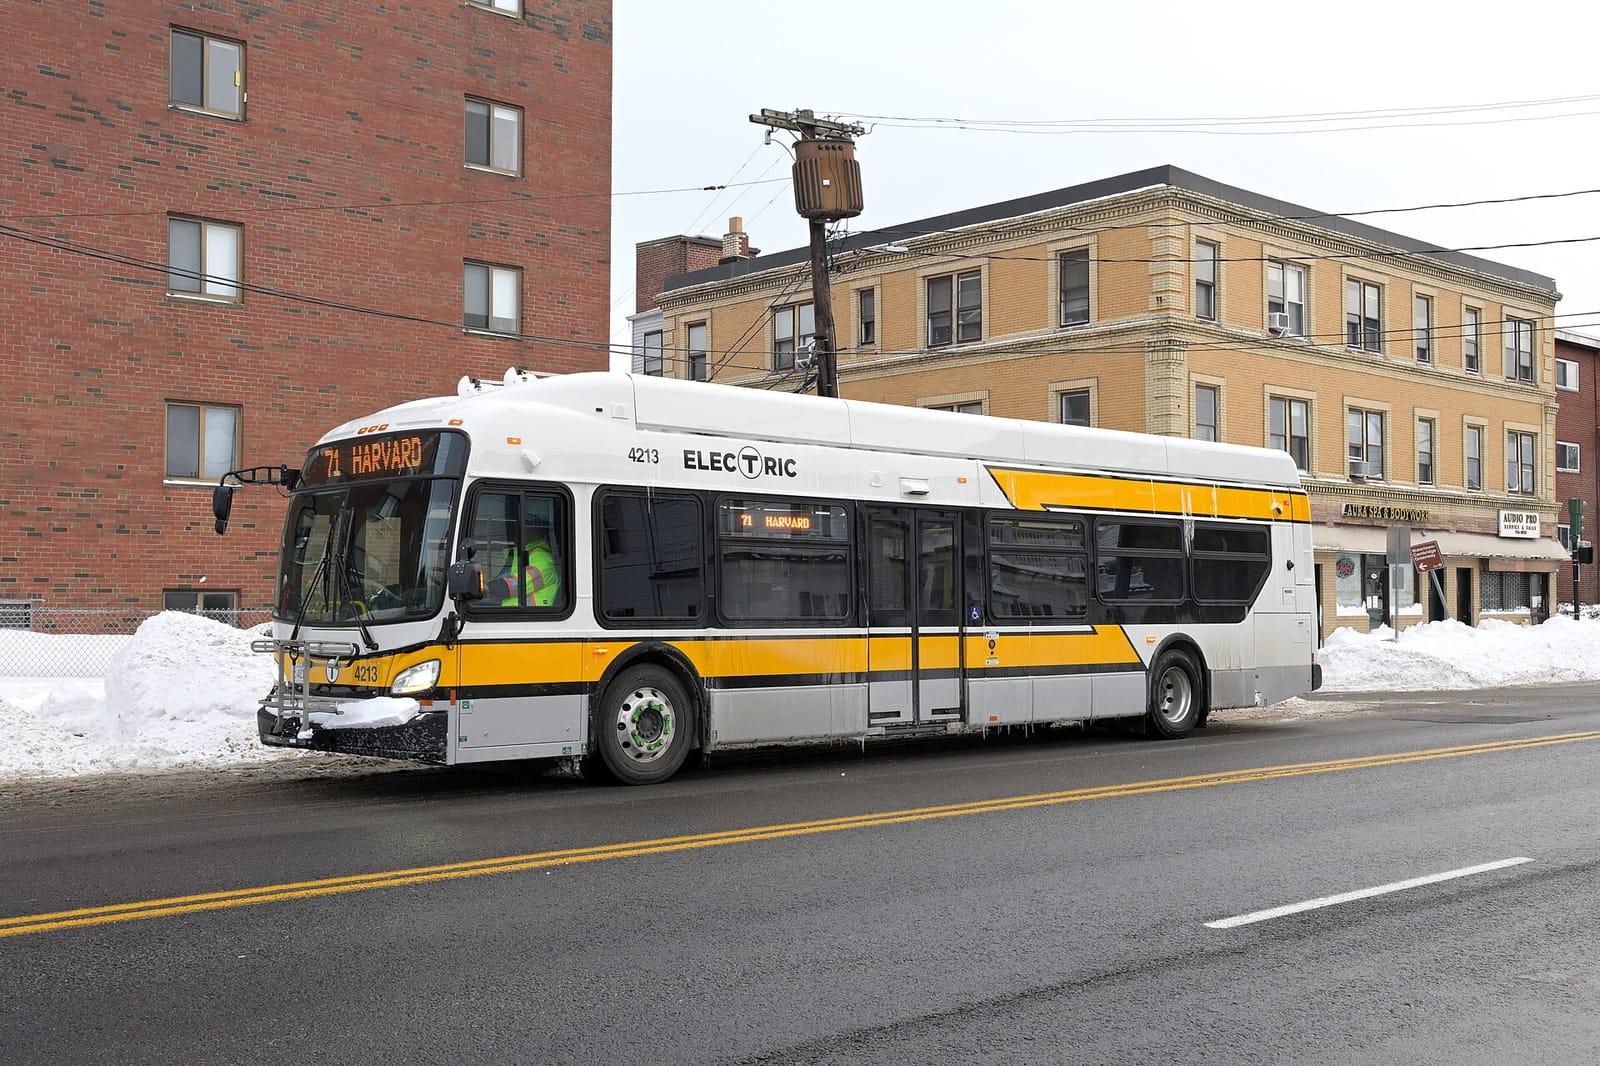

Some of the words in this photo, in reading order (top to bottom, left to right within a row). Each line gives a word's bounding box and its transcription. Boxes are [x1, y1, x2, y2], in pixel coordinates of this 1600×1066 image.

[324, 449, 341, 477] 71
[352, 436, 422, 475] HARVARD
[628, 447, 659, 464] 4213
[683, 446, 797, 479] ELECTRIC
[1347, 503, 1367, 517] AURA
[1369, 505, 1381, 519] SPA
[1383, 507, 1389, 519] &
[1503, 513, 1523, 523] AUDIO
[1525, 514, 1537, 524] PRO
[741, 514, 752, 526] 71
[765, 515, 810, 529] HARVARD
[354, 664, 378, 682] 4213
